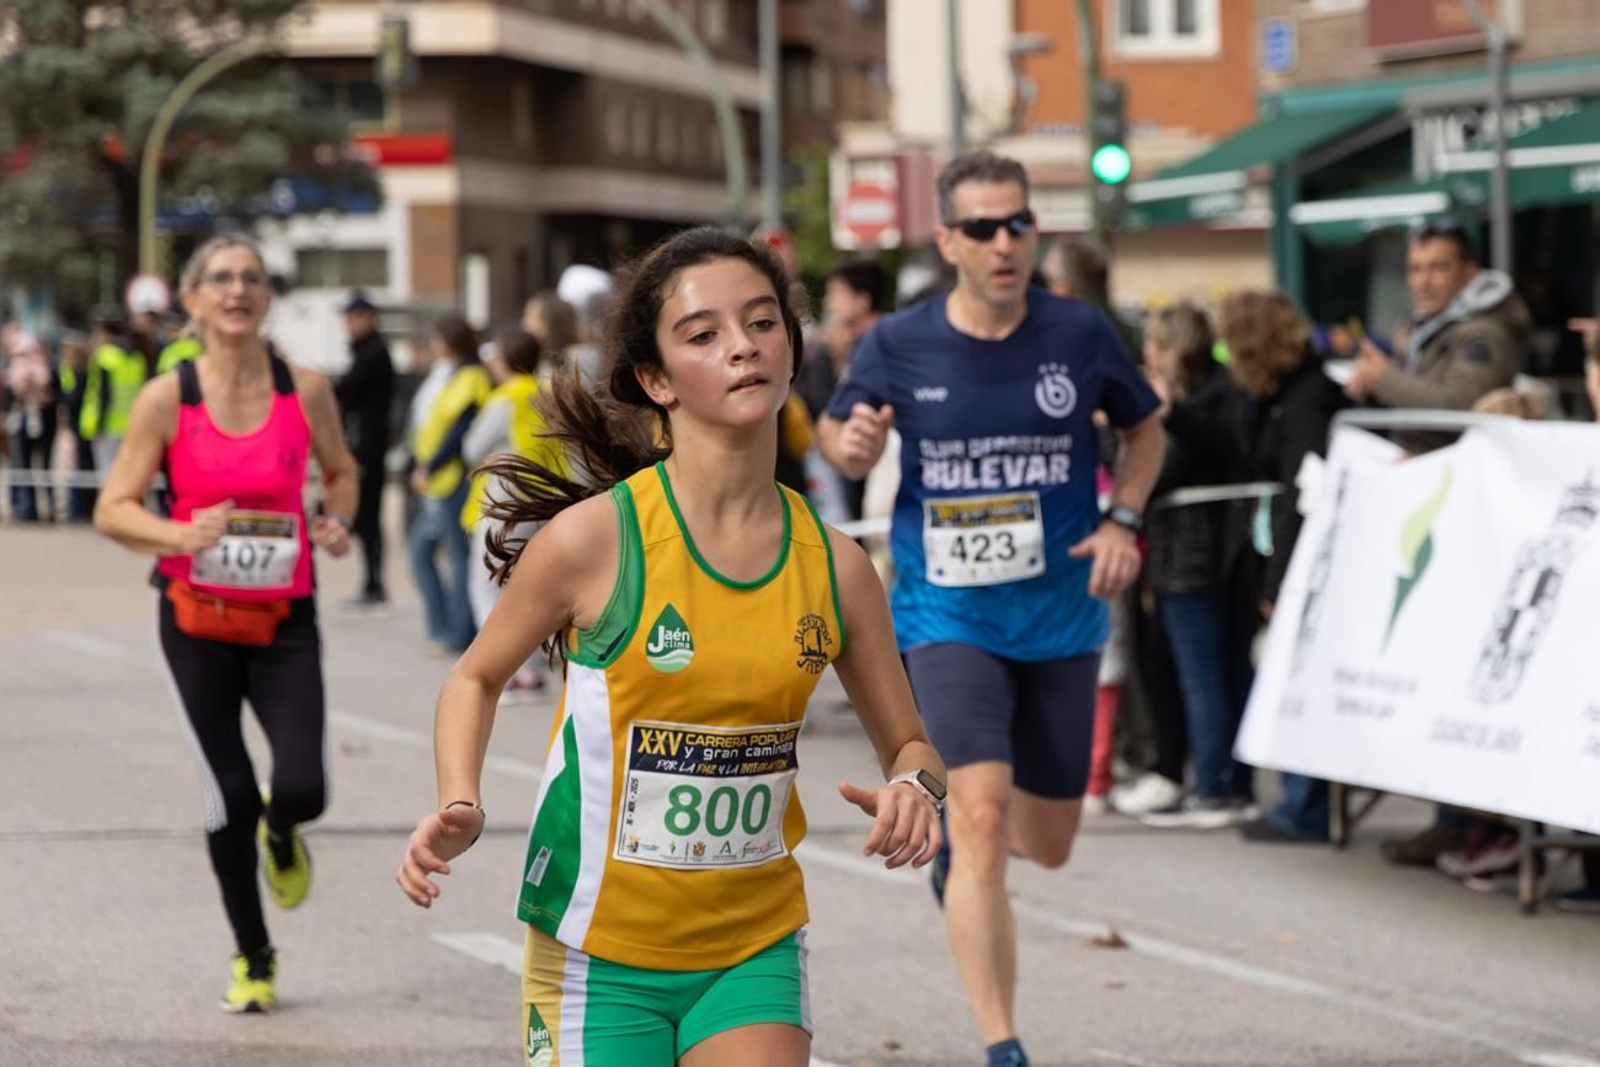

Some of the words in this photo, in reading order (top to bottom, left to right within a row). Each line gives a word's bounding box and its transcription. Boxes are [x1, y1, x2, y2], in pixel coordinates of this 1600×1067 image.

[920, 453, 1070, 490] BULEVAR
[222, 543, 275, 570] 107
[950, 531, 1017, 563] 423
[647, 625, 690, 653] Jaén
[637, 728, 683, 756] XXV
[685, 733, 748, 748] CARRERA
[703, 748, 739, 761] gran
[655, 759, 678, 770] POR
[679, 761, 696, 774] LA
[664, 783, 772, 837] 800
[528, 1026, 549, 1054] Jaén
